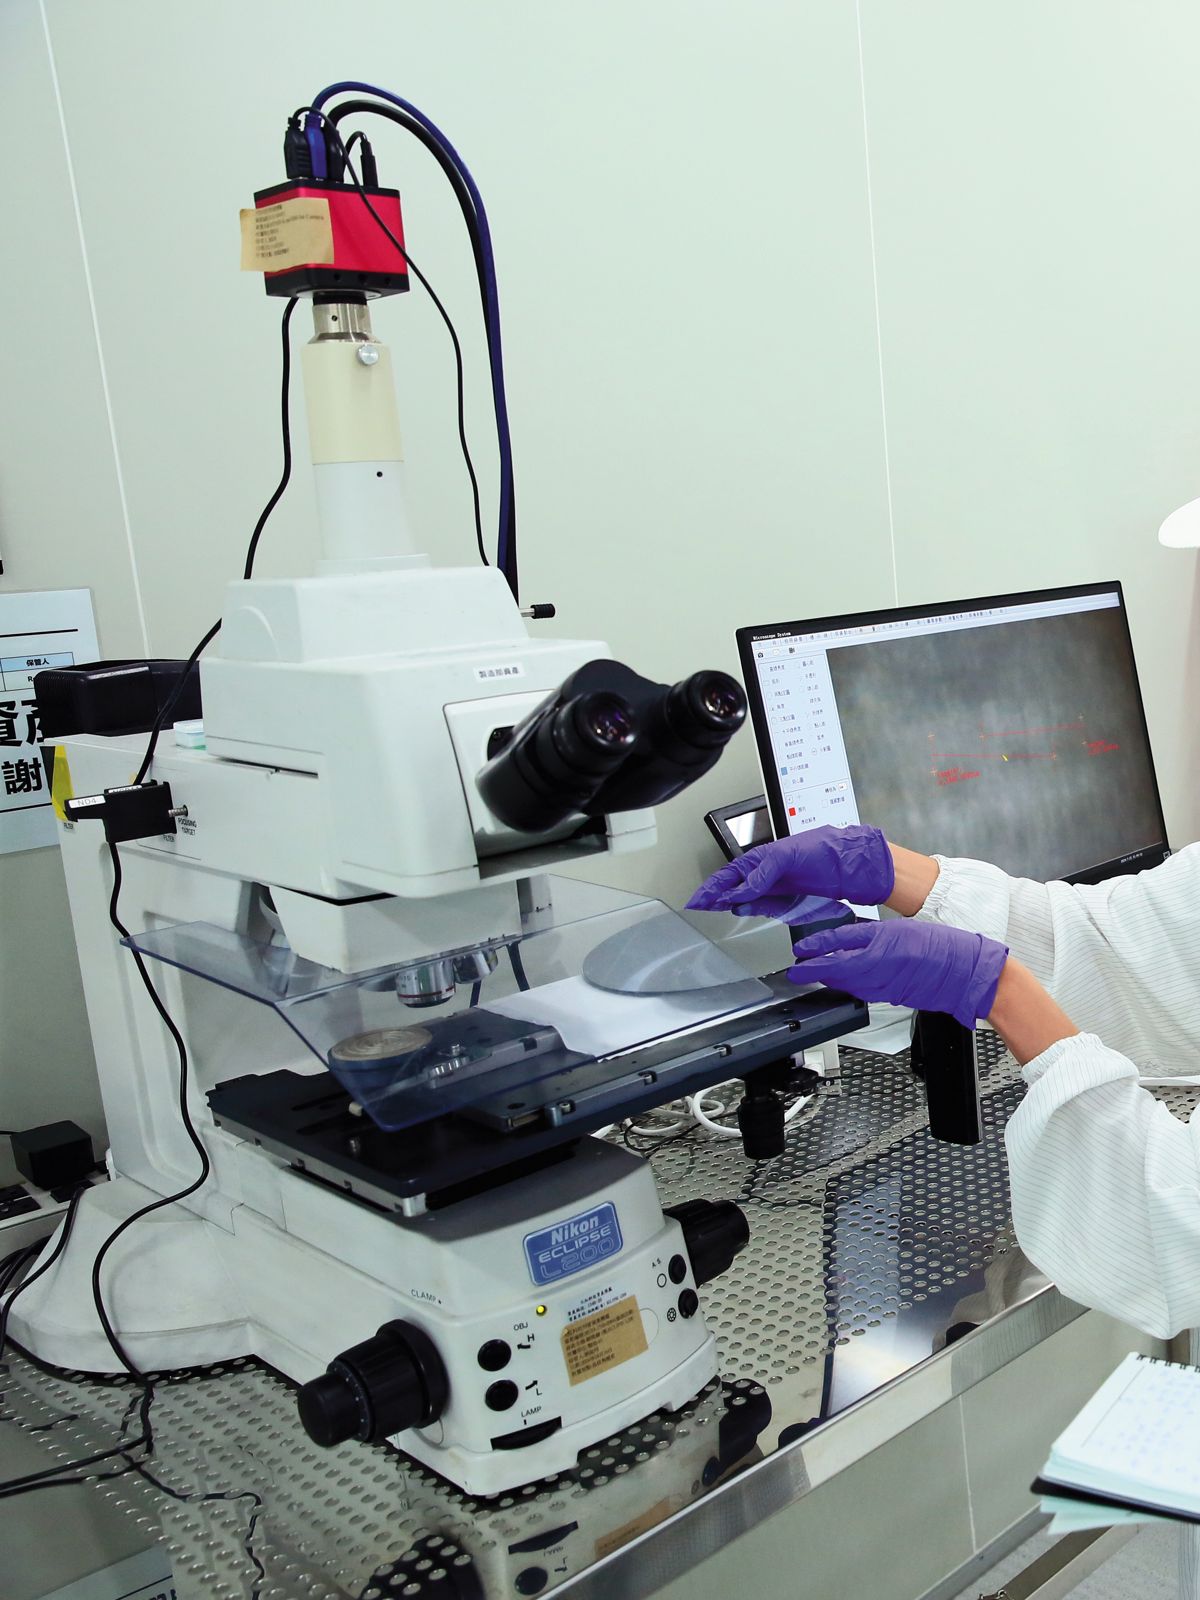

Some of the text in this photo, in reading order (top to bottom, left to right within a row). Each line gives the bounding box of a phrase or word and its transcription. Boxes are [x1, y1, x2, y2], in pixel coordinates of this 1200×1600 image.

[1, 757, 43, 795] 謝
[551, 1216, 599, 1245] Nikon
[538, 1225, 612, 1263] ECLIPSE
[540, 1237, 614, 1279] L200
[411, 1288, 437, 1302] CLAMP
[513, 1321, 529, 1331] OBJ
[527, 1333, 535, 1343] H
[536, 1388, 543, 1396] L
[521, 1406, 542, 1418] LAMP
